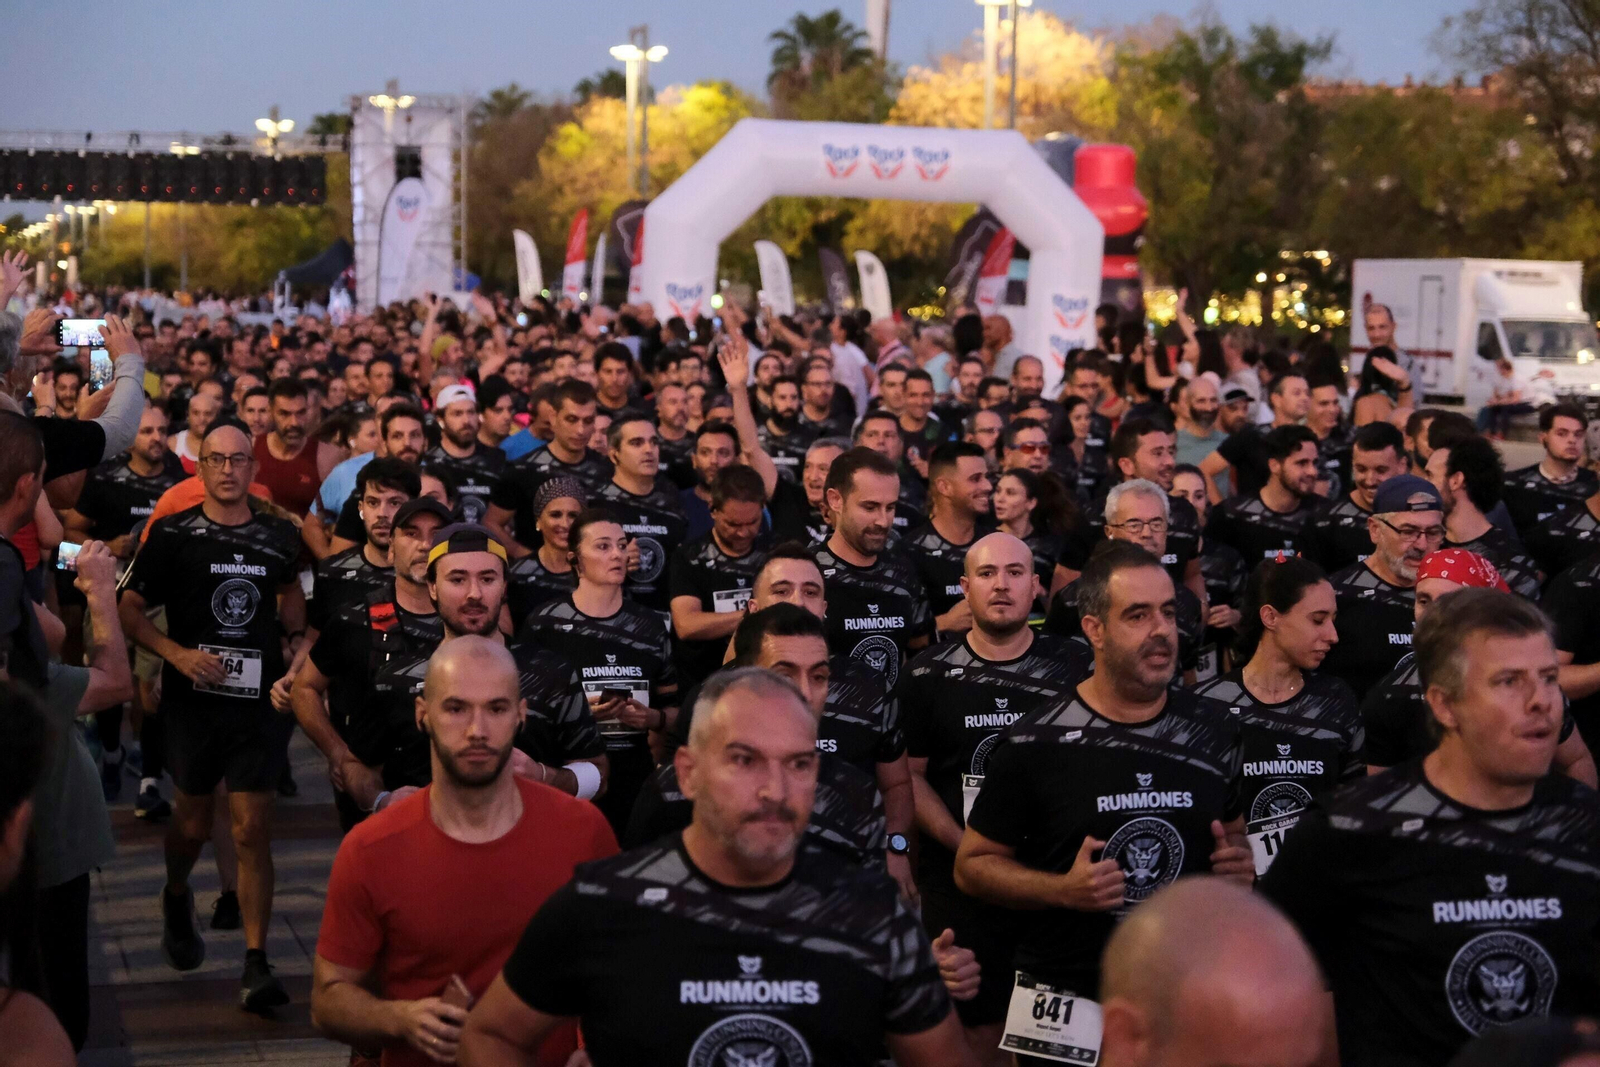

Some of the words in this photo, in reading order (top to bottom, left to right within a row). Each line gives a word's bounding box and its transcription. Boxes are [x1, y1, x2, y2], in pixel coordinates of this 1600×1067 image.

[210, 563, 266, 576] RUNMONES
[844, 616, 905, 631] RUNMONES
[220, 658, 244, 676] 64
[582, 666, 643, 678] RUNMONES
[964, 712, 1026, 729] RUNMON
[1243, 760, 1325, 777] RUNMONES
[1096, 791, 1194, 813] RUNMONES
[1261, 822, 1278, 832] ROCK
[1432, 897, 1562, 924] RUNMONES
[680, 980, 821, 1005] RUNMONES
[1032, 992, 1075, 1025] 841
